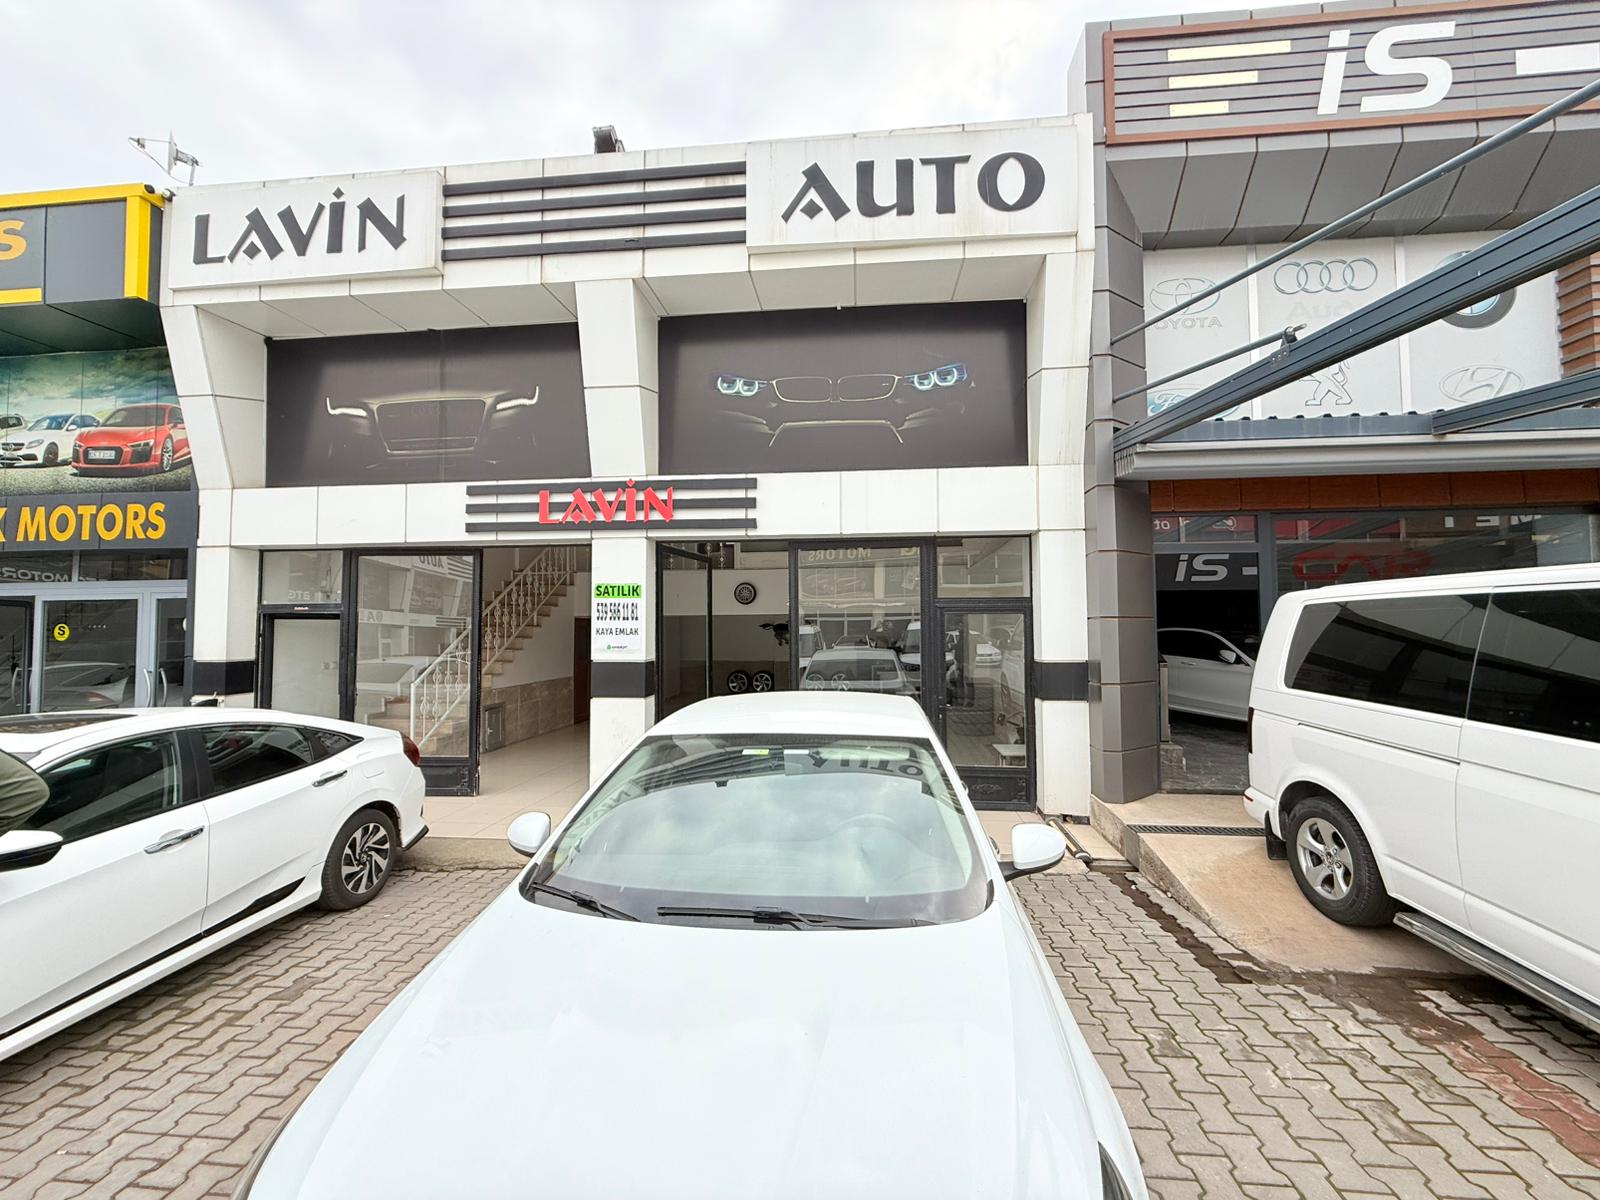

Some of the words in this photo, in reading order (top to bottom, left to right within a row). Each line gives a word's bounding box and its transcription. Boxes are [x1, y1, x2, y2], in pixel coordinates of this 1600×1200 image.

[781, 152, 1045, 223] AUTO
[1147, 316, 1222, 330] OYOTA
[16, 502, 166, 542] MOTORS
[595, 585, 640, 597] SATILIK
[622, 602, 629, 621] 11
[595, 627, 613, 636] KAYA
[615, 627, 639, 636] EMLAK
